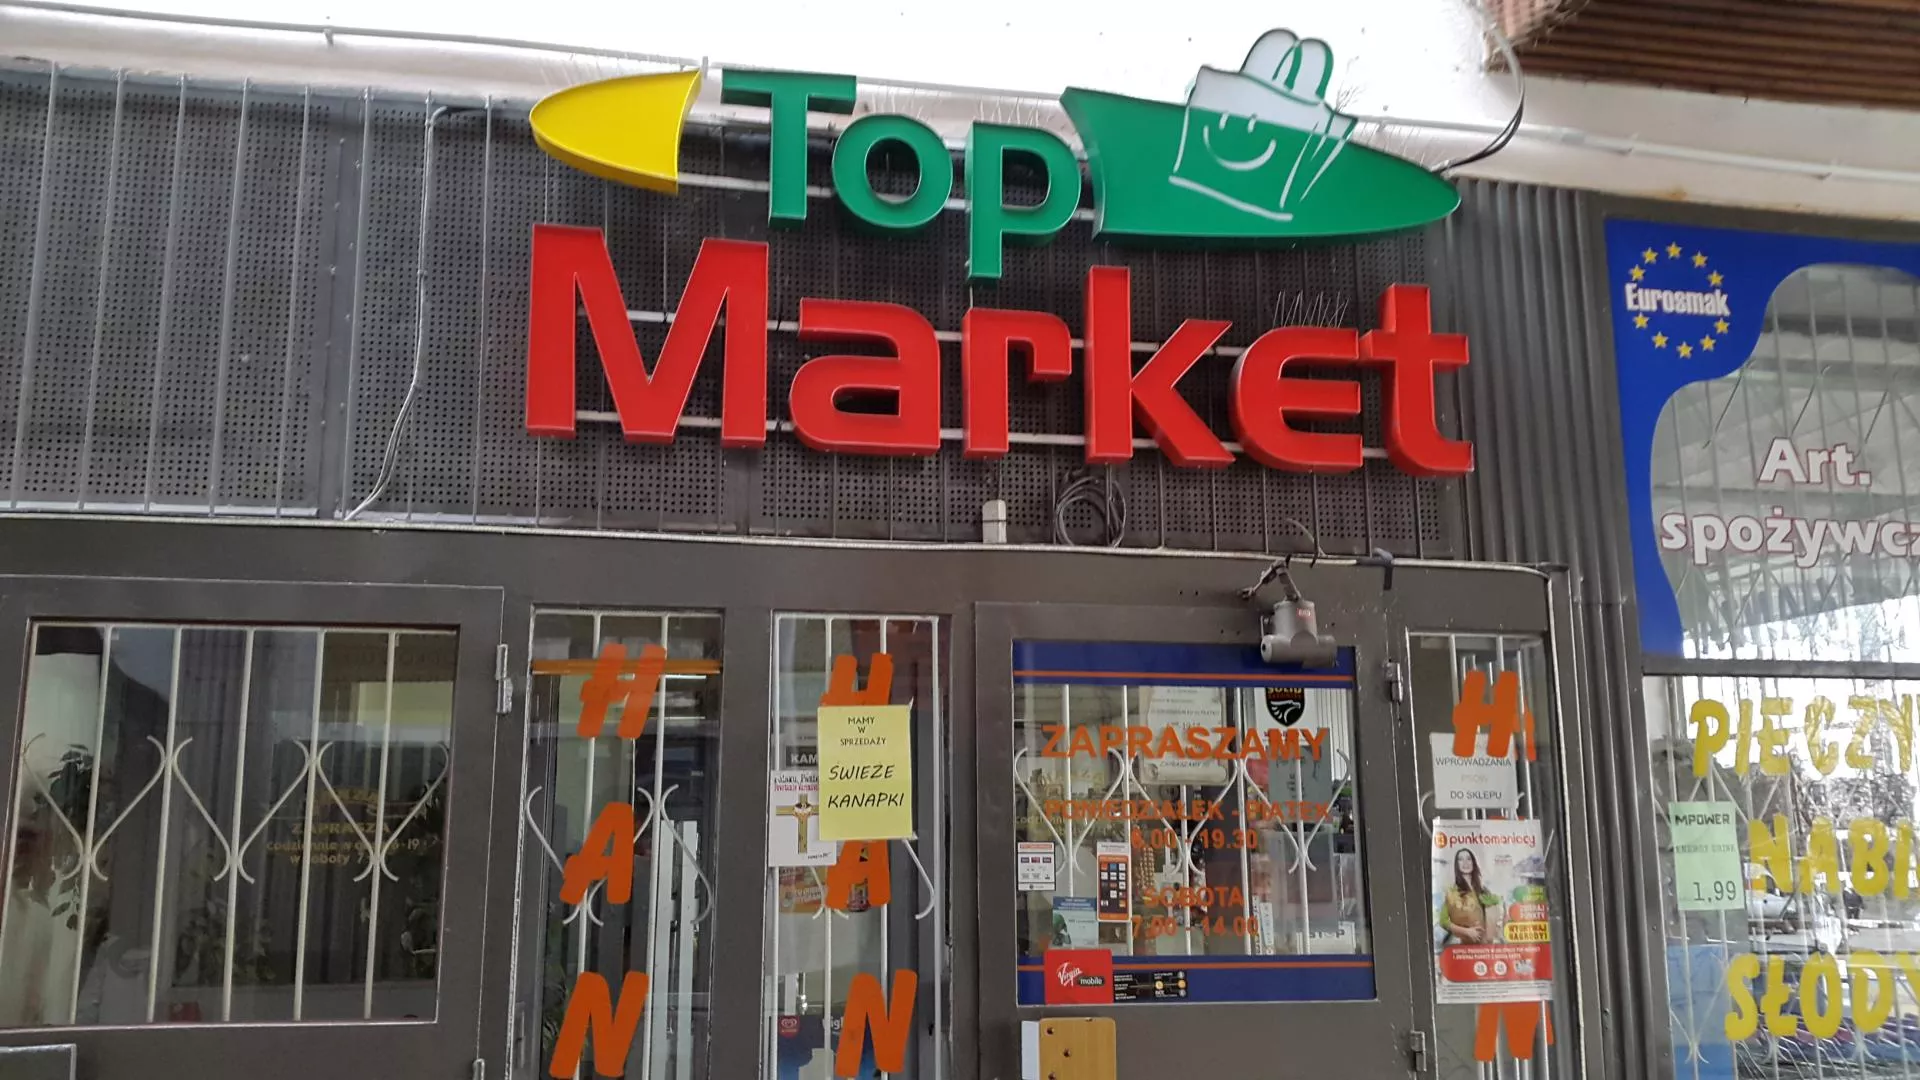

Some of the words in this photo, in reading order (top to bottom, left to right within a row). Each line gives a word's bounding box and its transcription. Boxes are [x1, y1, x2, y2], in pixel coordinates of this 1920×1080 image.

[722, 69, 1081, 280] Top
[1625, 282, 1731, 317] Eurosmak
[526, 224, 1474, 477] Market
[1758, 437, 1872, 486] Art.
[848, 717, 875, 725] MAMY
[857, 726, 866, 734] W
[1041, 725, 1328, 761] ZAPRASZAMY
[1690, 693, 1920, 778] PIECZY
[791, 753, 818, 764] KAM
[1435, 756, 1511, 767] WPROWADZANIA
[828, 793, 904, 808] KANAPKI
[1450, 790, 1464, 799] DO
[1467, 790, 1502, 799] SKLEPU
[1200, 828, 1257, 849] 19.30
[1748, 813, 1920, 900] NABI
[1144, 886, 1245, 908] SOBOTA
[1202, 915, 1259, 936] 14.00
[1057, 962, 1083, 987] Virgin
[1080, 977, 1103, 986] mobile
[1725, 950, 1920, 1040] SŁOD
